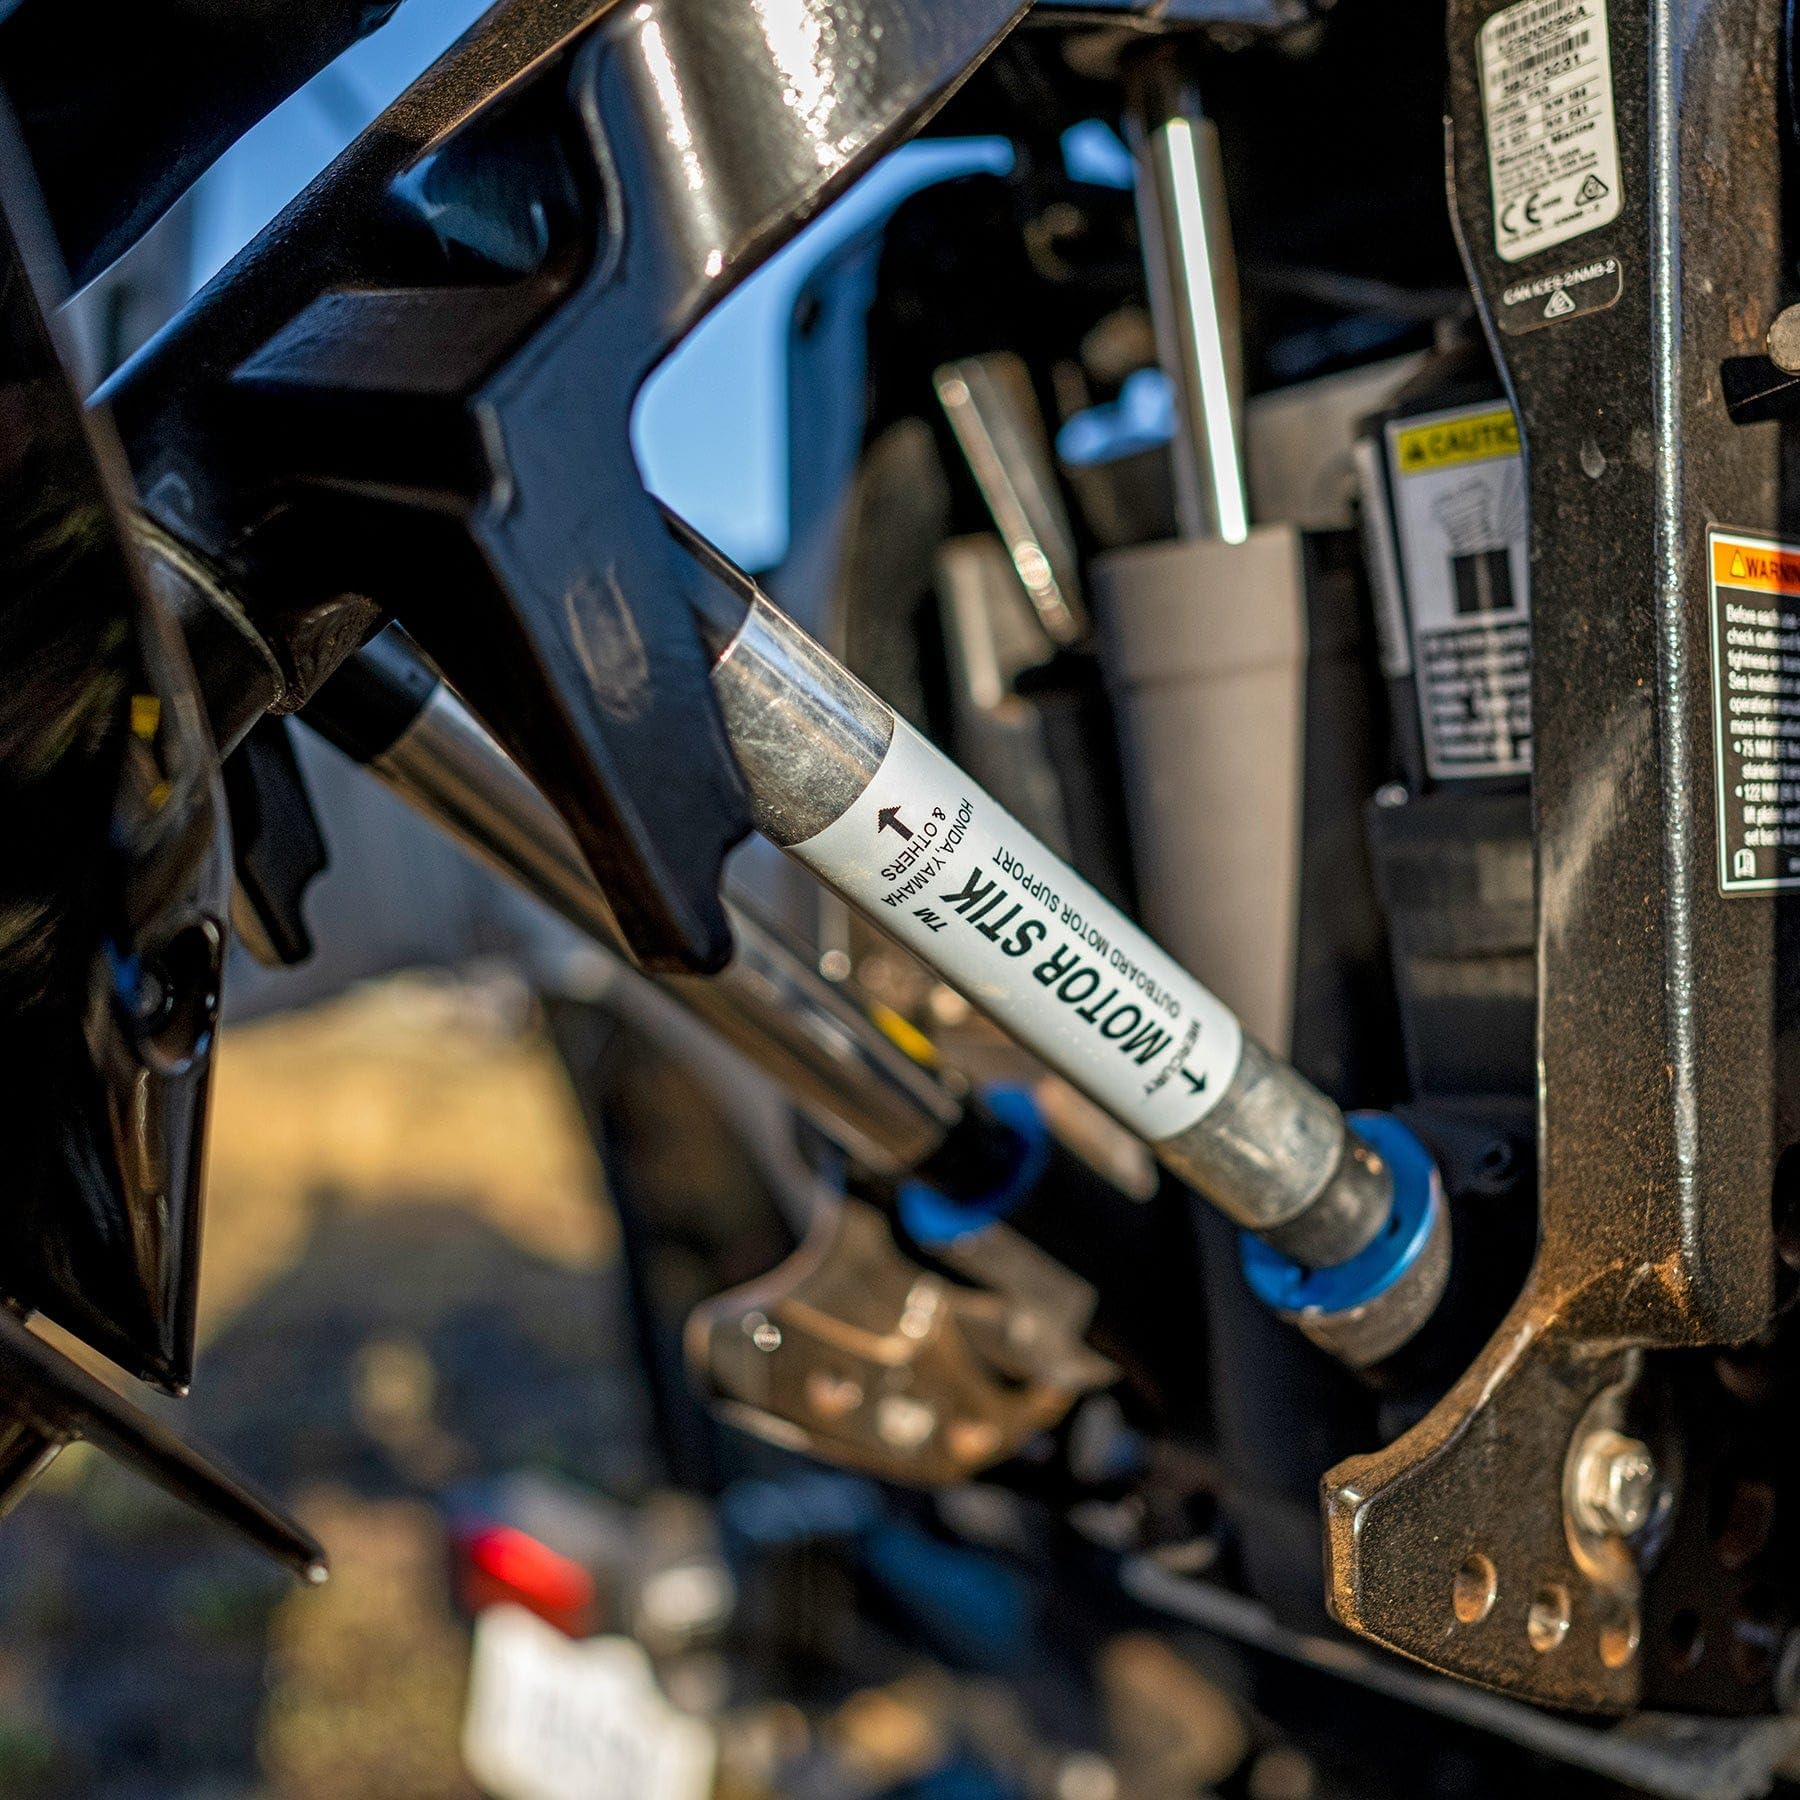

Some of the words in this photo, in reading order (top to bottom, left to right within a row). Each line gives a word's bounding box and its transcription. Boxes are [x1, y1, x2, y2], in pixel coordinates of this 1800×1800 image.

[1729, 670, 1747, 690] See
[932, 807, 946, 822] &
[934, 797, 975, 855] HONDA,
[880, 821, 939, 882] OTHERS
[992, 846, 1060, 916] SUPPORT
[881, 855, 946, 908] YAMAHA
[940, 866, 1048, 958] STIK
[1060, 904, 1110, 954] MOTOR
[1033, 944, 1174, 1065] MOTOR
[1109, 944, 1181, 1019] OUTBOARD
